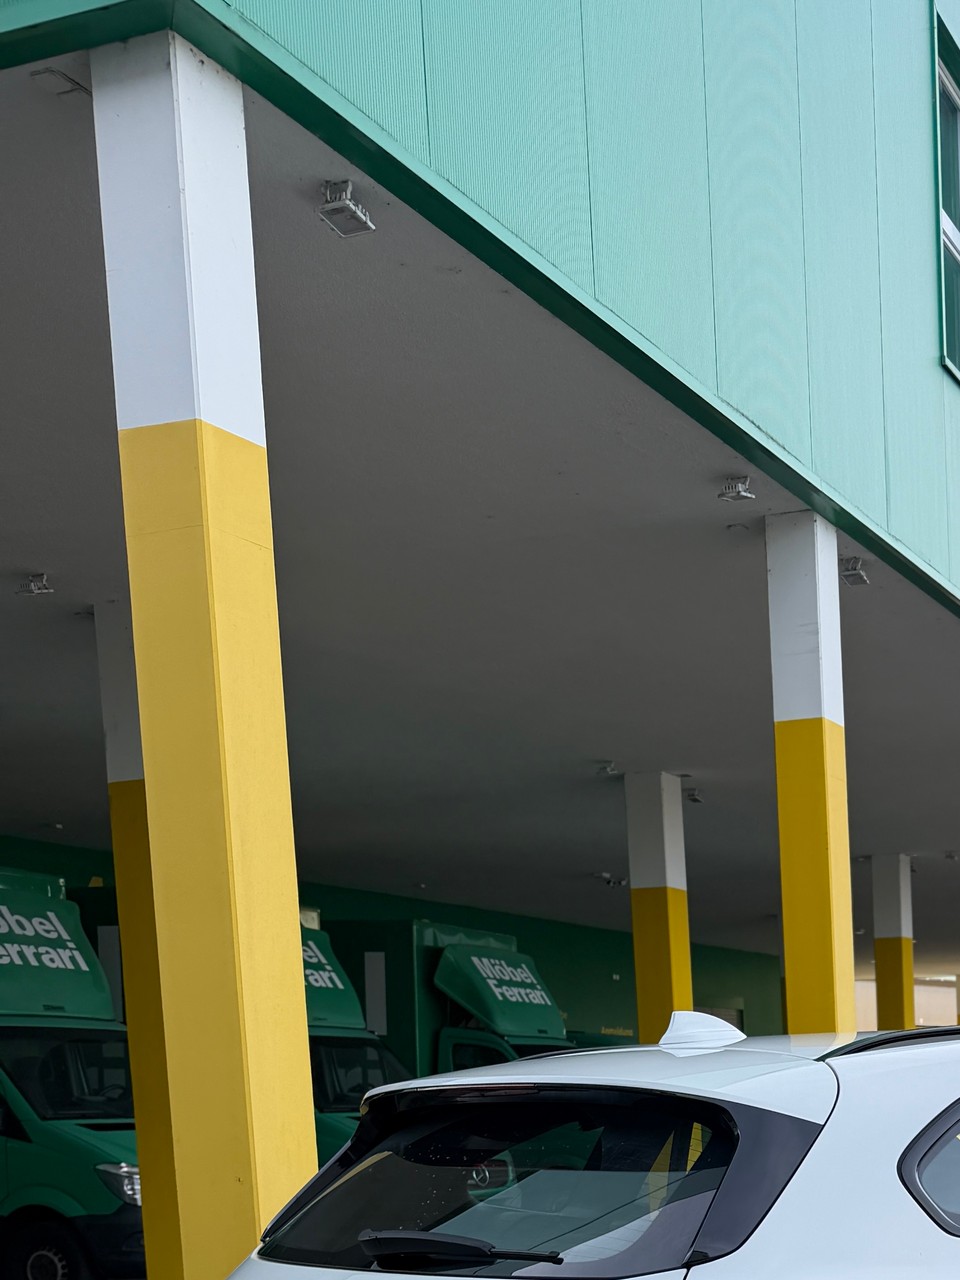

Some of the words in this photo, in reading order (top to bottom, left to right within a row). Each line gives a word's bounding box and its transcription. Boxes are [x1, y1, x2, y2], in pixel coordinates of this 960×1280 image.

[305, 964, 344, 989] ari
[471, 956, 537, 984] Möbel
[486, 978, 552, 1006] Ferrari
